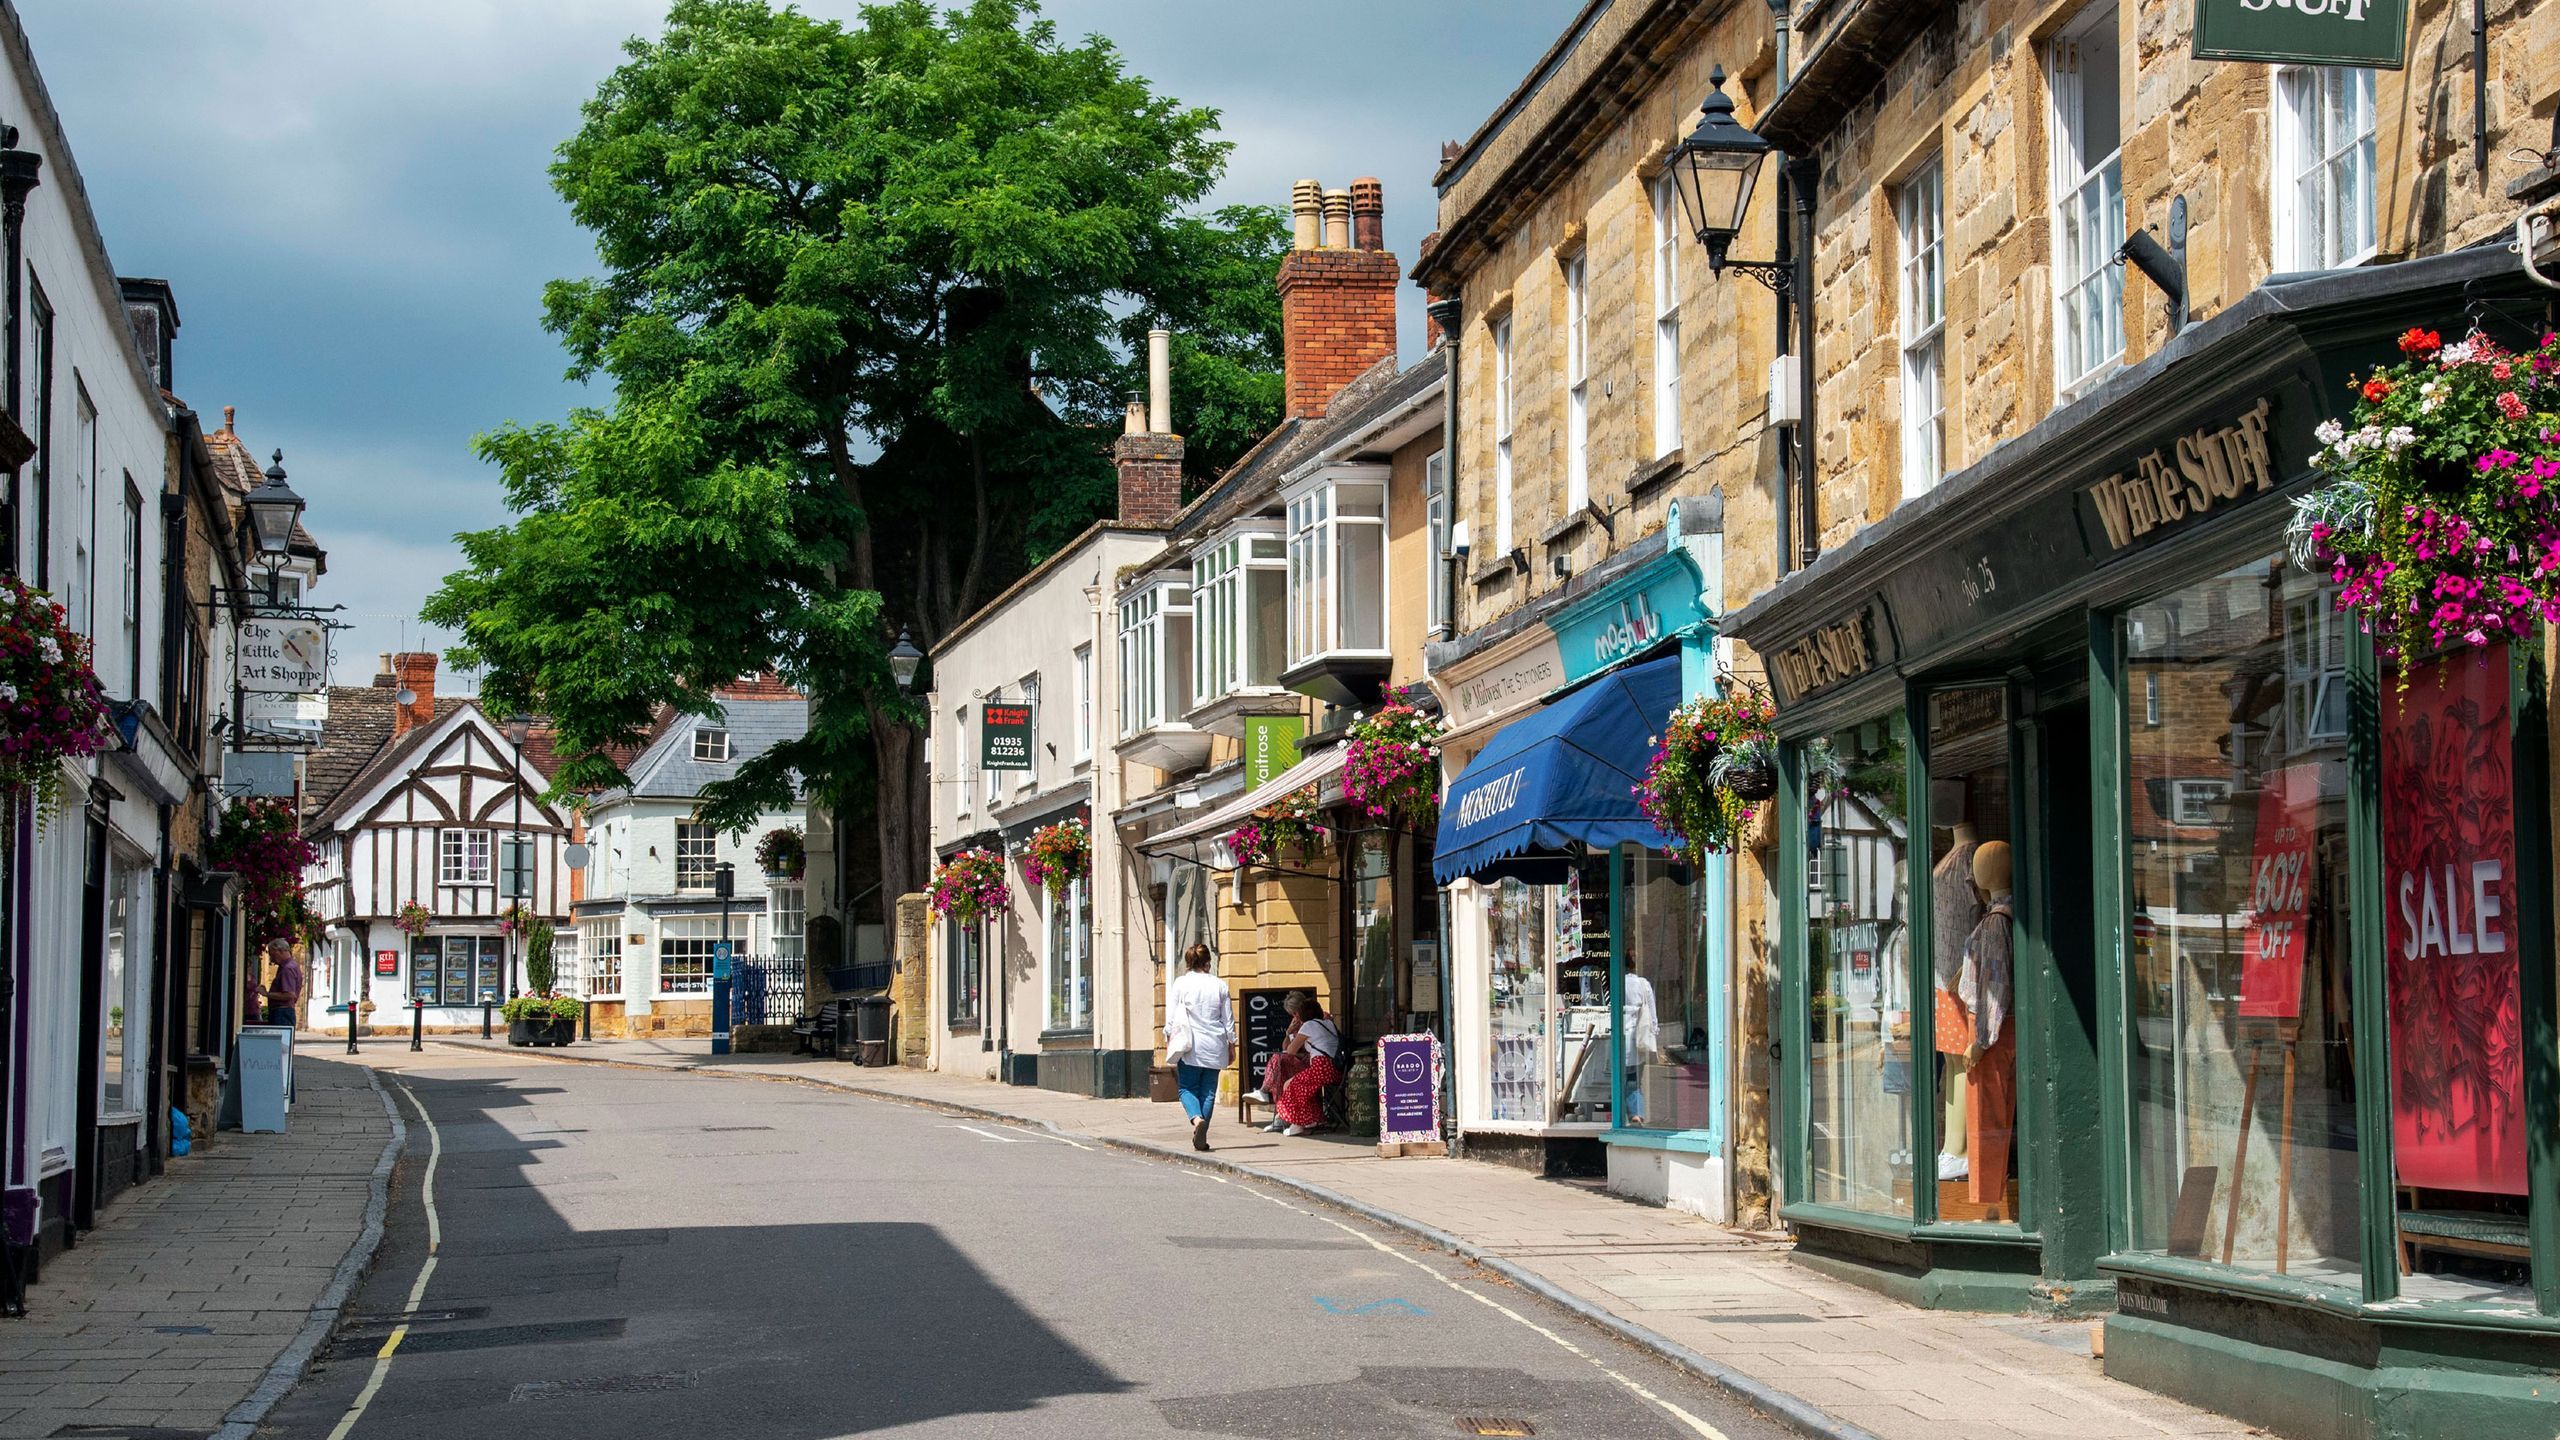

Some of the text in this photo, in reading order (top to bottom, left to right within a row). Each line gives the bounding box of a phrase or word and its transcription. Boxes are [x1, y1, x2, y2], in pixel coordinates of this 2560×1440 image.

[1978, 555, 1996, 593] 25
[243, 623, 271, 641] The
[1594, 592, 1660, 661] moshulu
[242, 644, 280, 659] Little
[241, 664, 322, 687] Art Shoppe
[1515, 661, 1553, 691] STATIONERS
[1003, 708, 1029, 719] Knight
[1003, 717, 1025, 725] Frank
[990, 746, 1025, 756] 812236
[993, 736, 1022, 746] 01935
[1455, 766, 1526, 831] MOSHULU
[2274, 828, 2296, 844] UP TO
[2255, 850, 2305, 913] 60%
[2400, 859, 2506, 961] SALE
[1830, 922, 1879, 954] NEW PRINTS
[2259, 921, 2293, 961] OFF
[379, 952, 394, 963] gth
[1563, 969, 1601, 980] Stationery
[2119, 1291, 2169, 1315] PETS WELCOME
